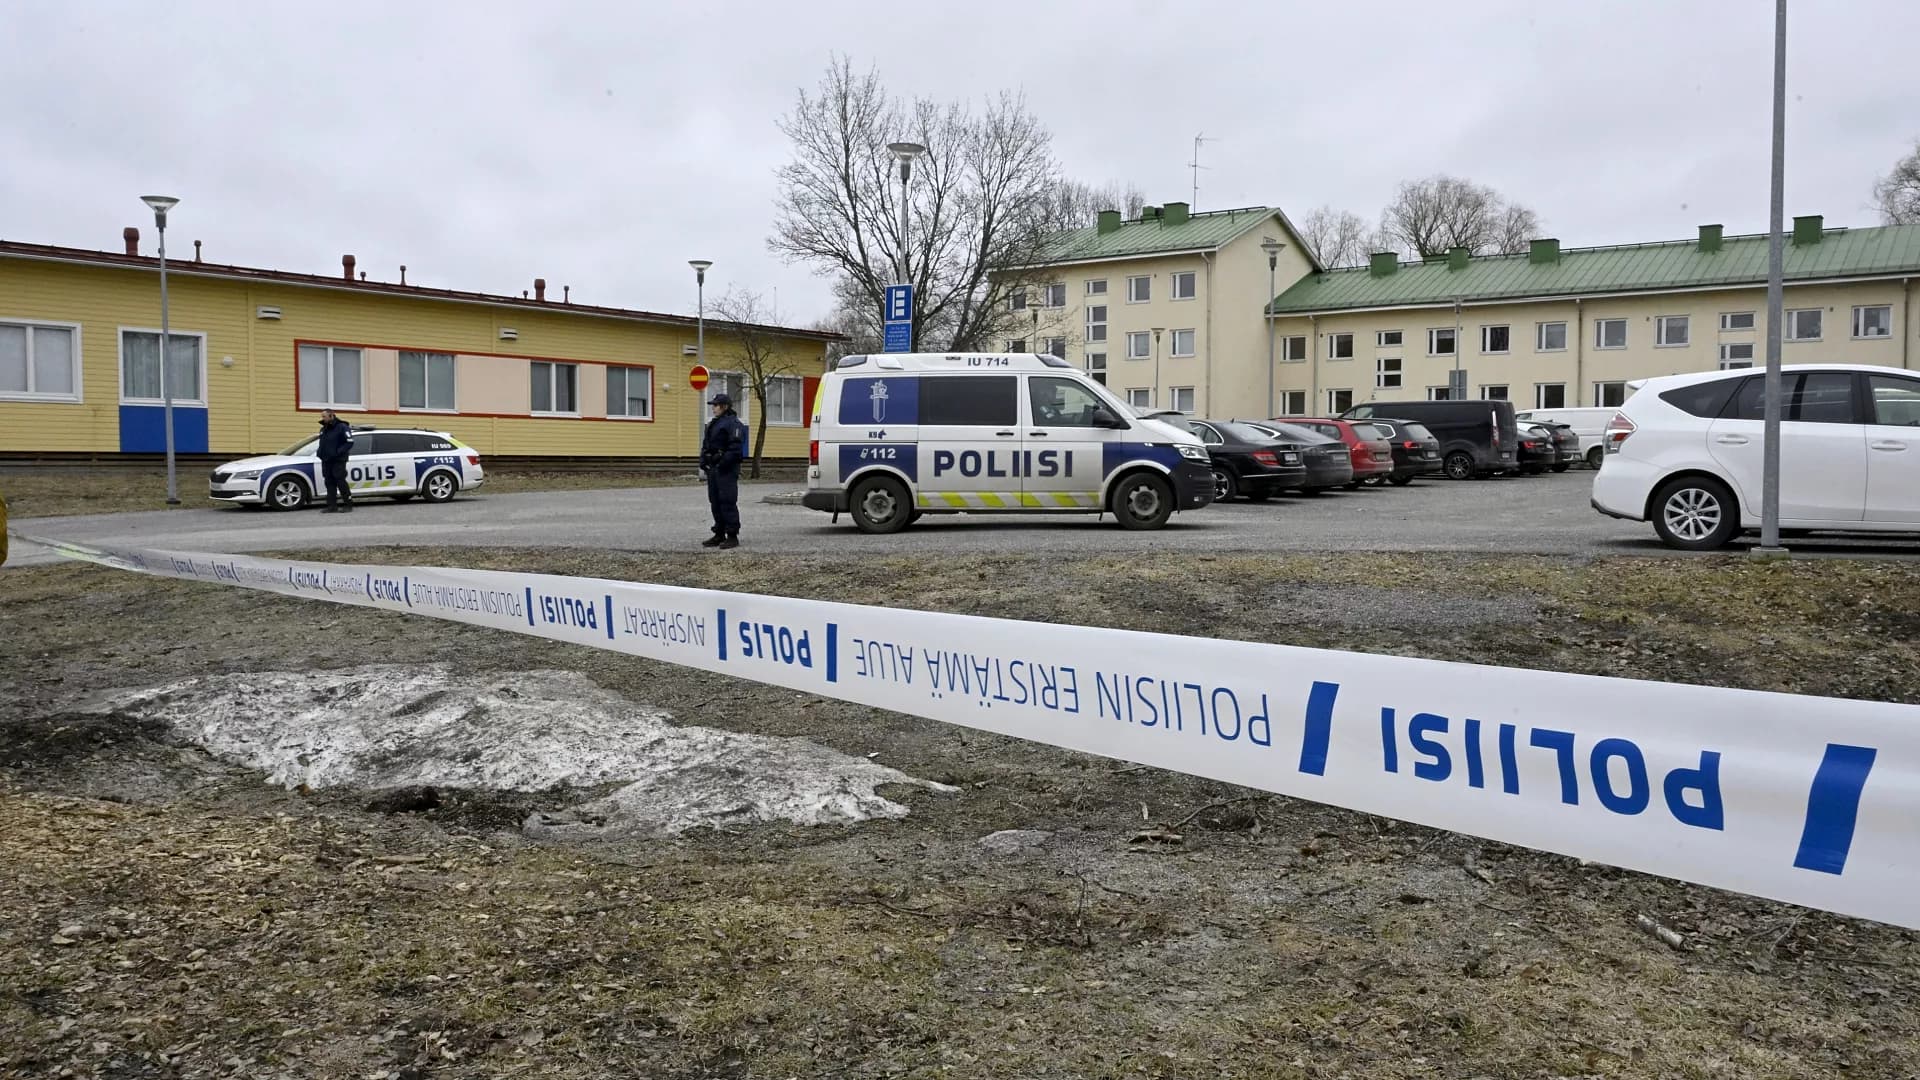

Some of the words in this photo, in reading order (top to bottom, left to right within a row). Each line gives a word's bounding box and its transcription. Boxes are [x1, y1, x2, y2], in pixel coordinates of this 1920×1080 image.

[968, 357, 981, 366] IU
[985, 357, 1008, 366] 714
[871, 448, 896, 459] 112
[933, 450, 1073, 478] POLIISI
[350, 465, 396, 482] OLIS
[374, 579, 402, 602] POLIS
[540, 595, 598, 629] POLIISI
[624, 606, 706, 647] AVSPÄRRAT
[739, 621, 812, 668] POLIS
[852, 638, 913, 685] ALUE
[923, 648, 1080, 714] ERISTÄMÄ
[1096, 671, 1272, 747] POLIISIN
[1380, 706, 1724, 831] POLIISI
